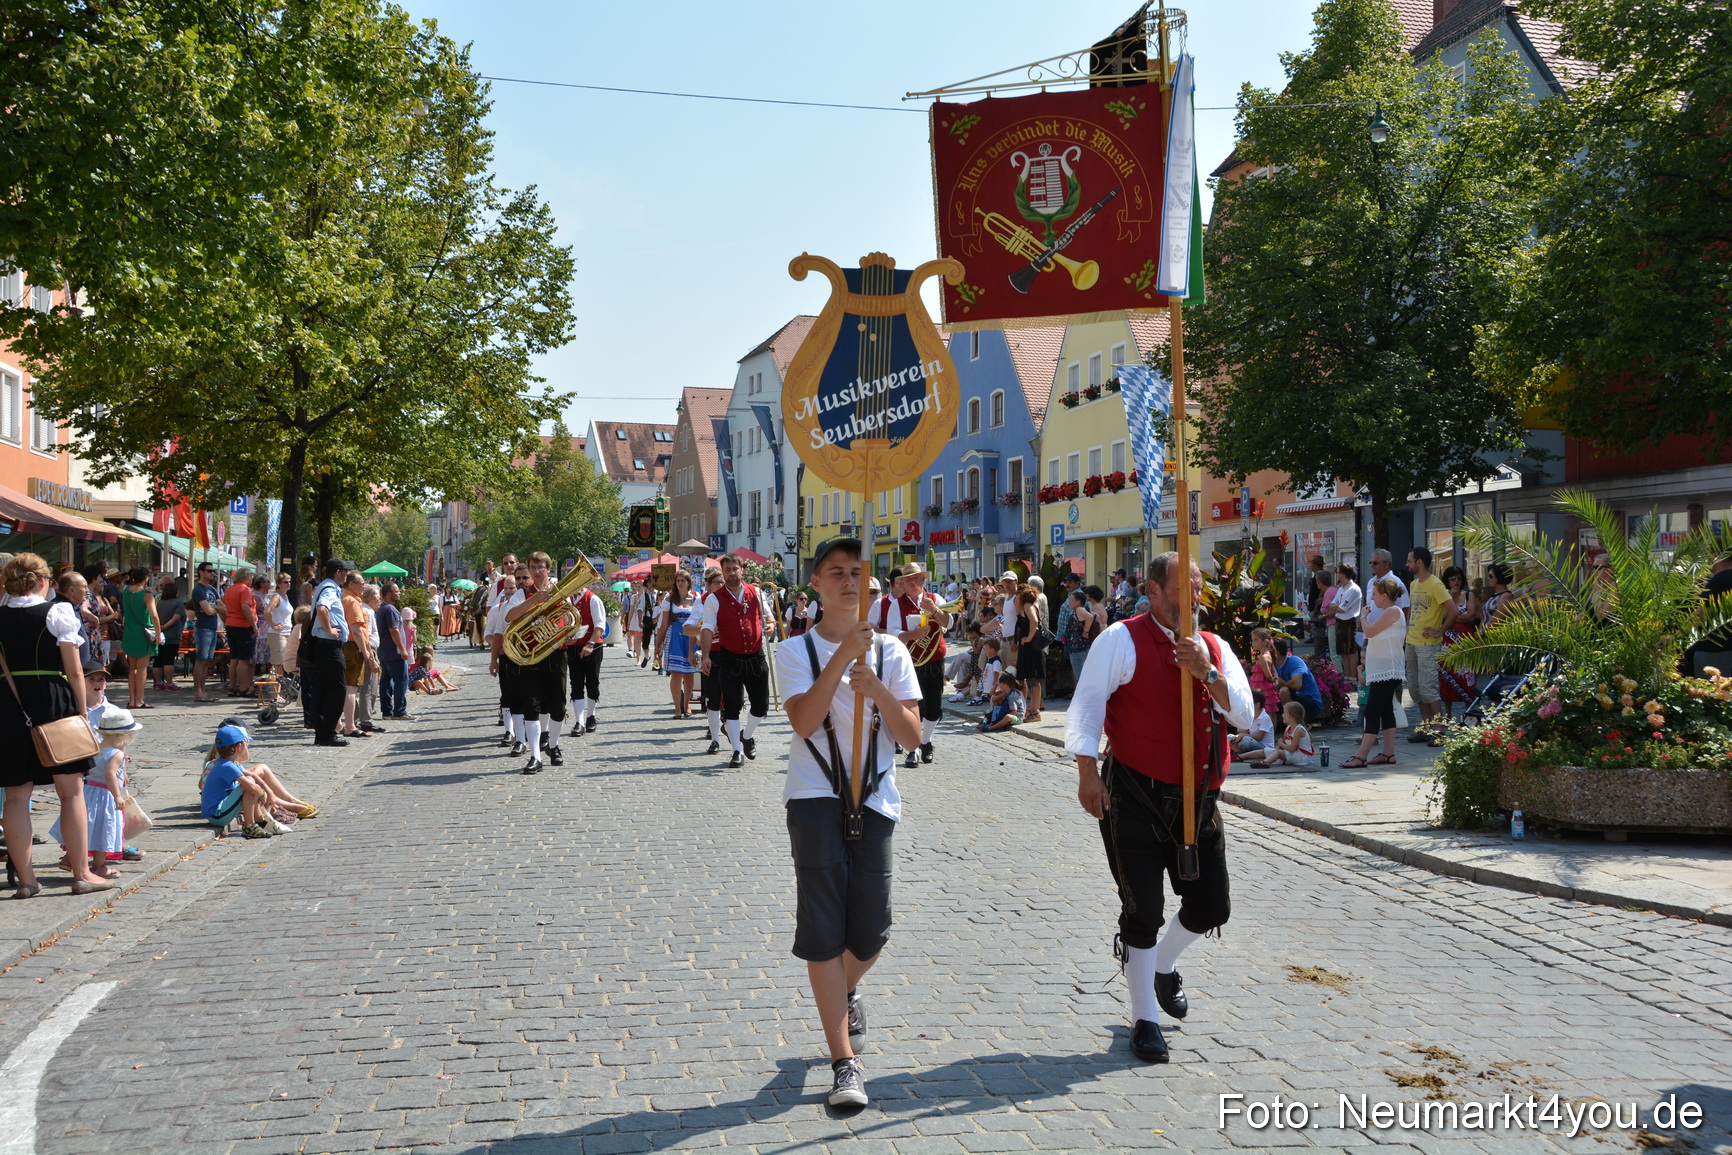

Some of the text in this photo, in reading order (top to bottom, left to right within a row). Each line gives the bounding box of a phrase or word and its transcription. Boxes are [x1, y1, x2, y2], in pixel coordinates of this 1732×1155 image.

[958, 158, 988, 193] Uns
[986, 119, 1060, 159] verbindet
[1065, 120, 1087, 141] die
[1088, 128, 1137, 179] Musik
[795, 358, 944, 421] Musikverein
[810, 381, 942, 449] Seubersdorf
[1053, 526, 1062, 544] P
